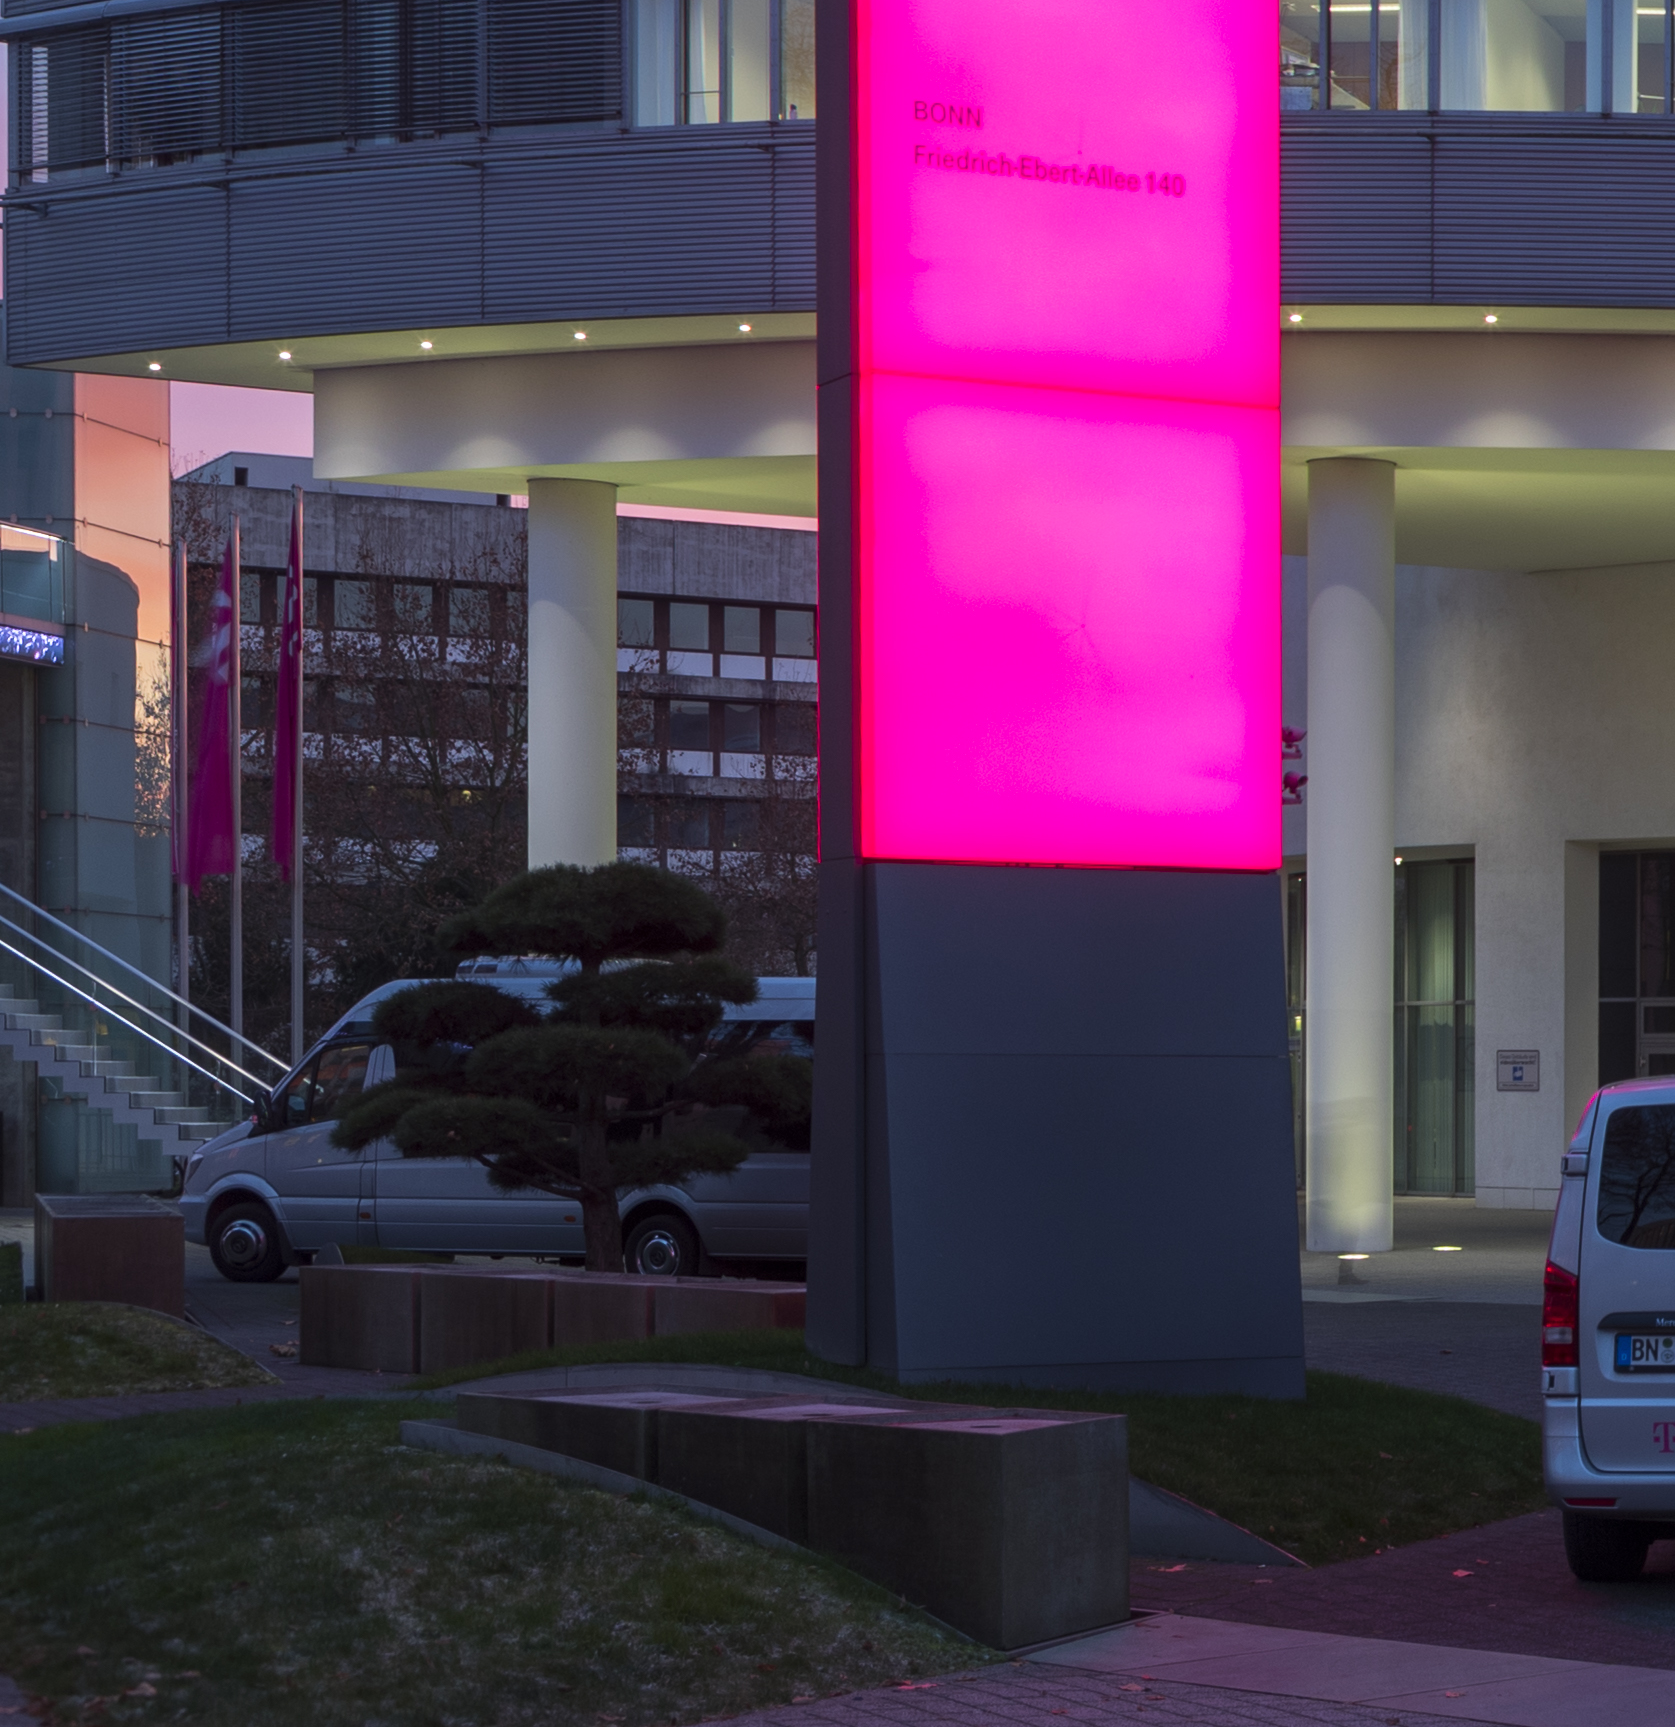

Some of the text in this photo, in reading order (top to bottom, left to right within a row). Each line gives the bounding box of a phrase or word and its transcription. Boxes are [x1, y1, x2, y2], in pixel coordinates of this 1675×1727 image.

[913, 99, 982, 128] BONN
[913, 144, 1185, 196] Friedrich-Ebert-Allee 140
[1631, 1338, 1659, 1362] BN
